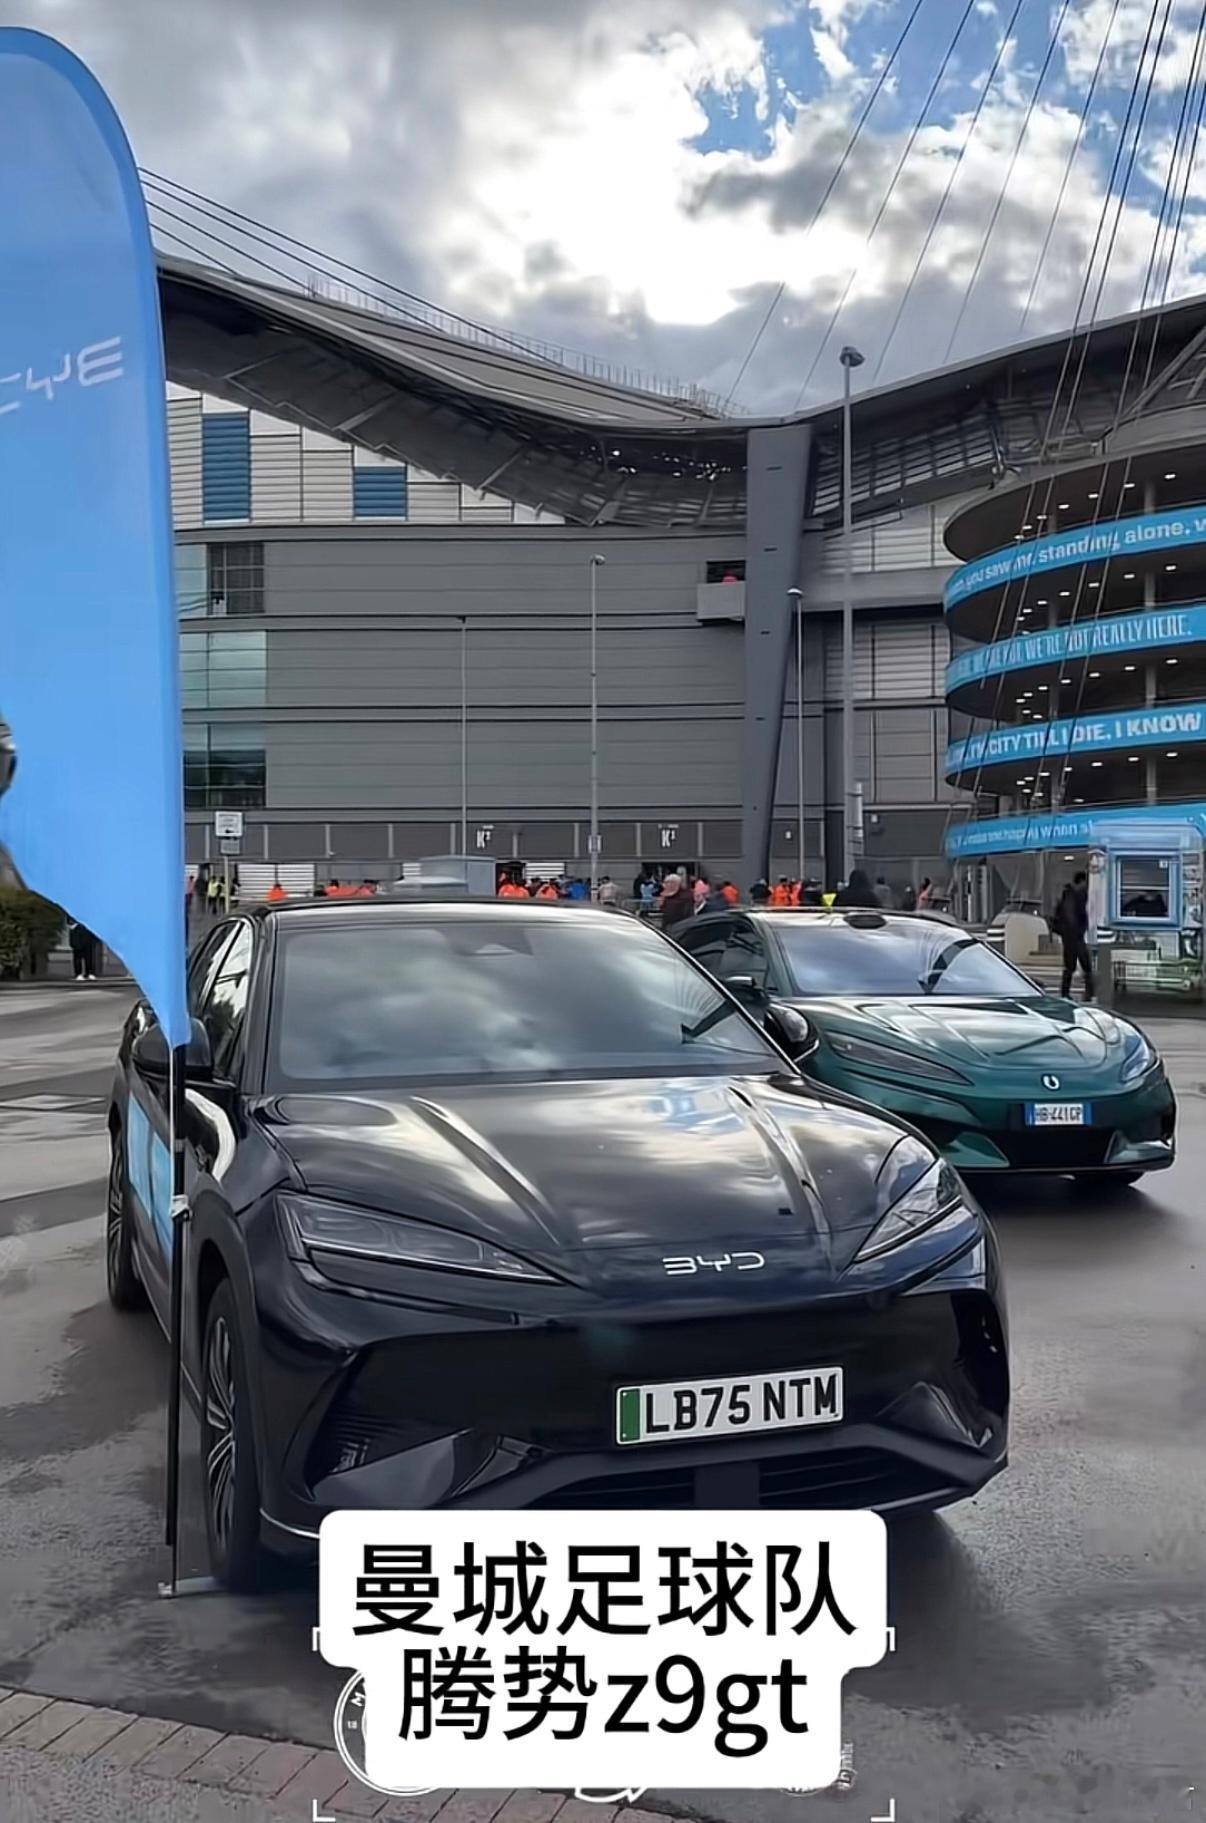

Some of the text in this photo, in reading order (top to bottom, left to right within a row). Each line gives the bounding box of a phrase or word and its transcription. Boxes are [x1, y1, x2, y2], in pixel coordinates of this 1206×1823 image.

[1125, 520, 1190, 545] alone.
[989, 733, 1022, 755] CITY
[1023, 729, 1060, 750] TILL
[1115, 723, 1122, 738] I
[1126, 710, 1202, 738] KNOW
[662, 1251, 765, 1275] BYD
[645, 1373, 838, 1434] LB75 NTM
